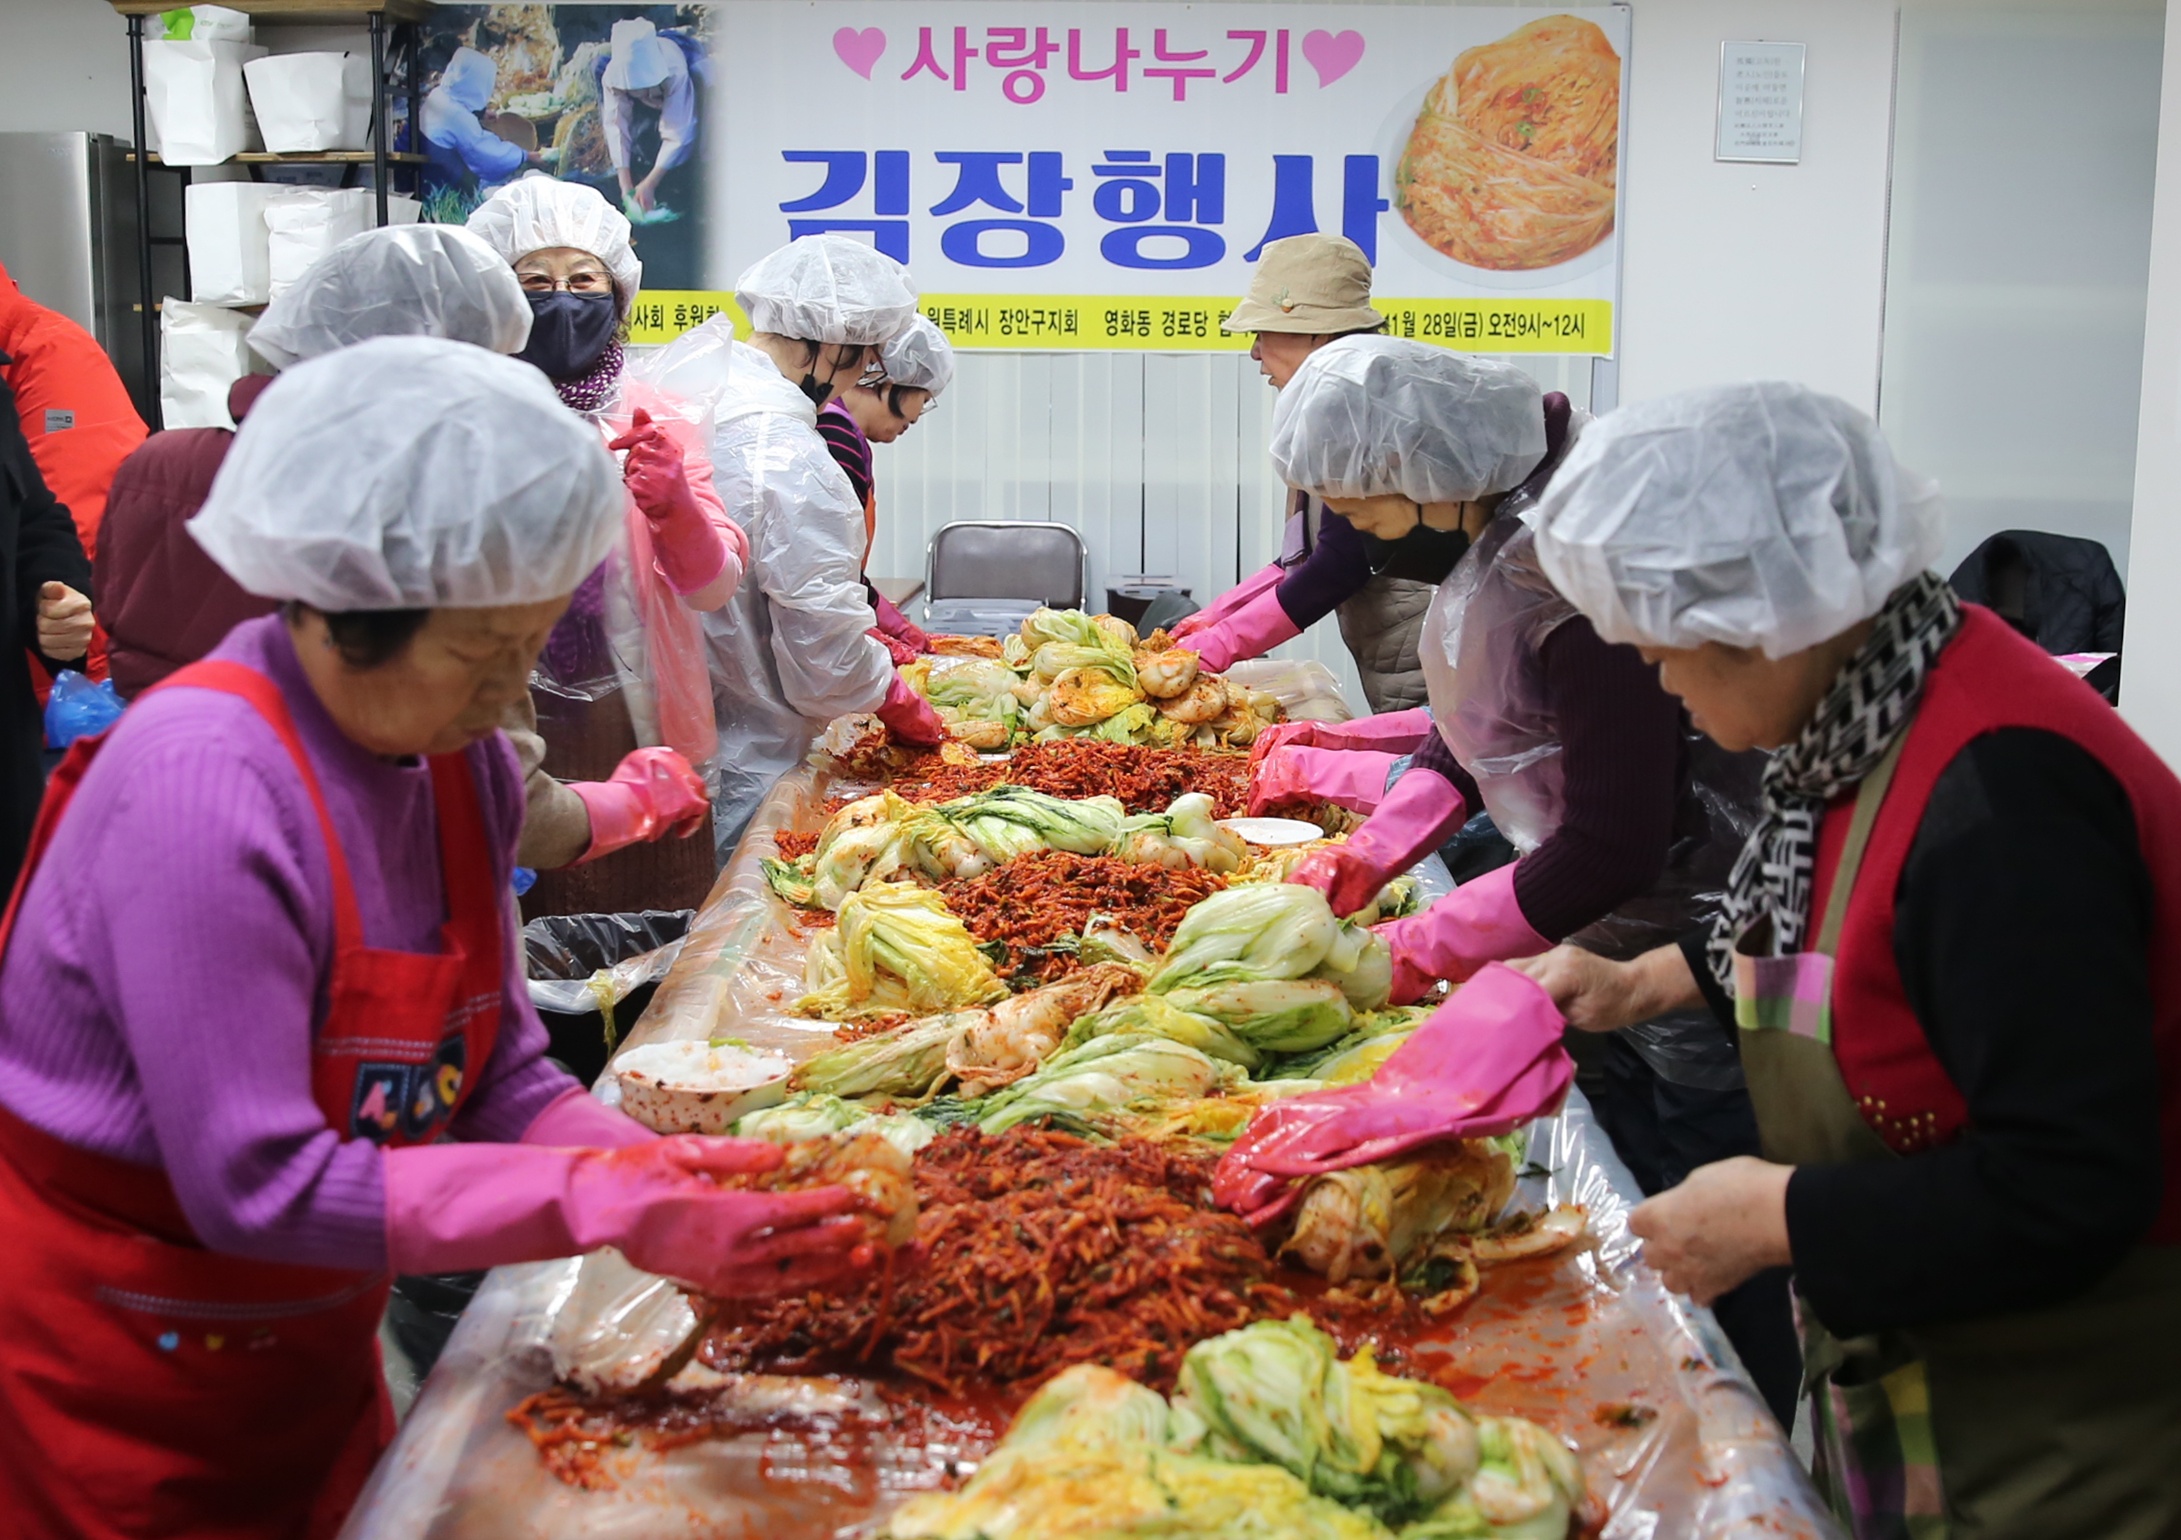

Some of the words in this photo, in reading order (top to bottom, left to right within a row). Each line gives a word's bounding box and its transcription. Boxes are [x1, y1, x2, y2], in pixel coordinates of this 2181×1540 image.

[901, 26, 1289, 105] 사랑나누기
[778, 149, 1390, 270] 김장행사
[629, 304, 664, 331] 사회
[916, 307, 989, 335] 원특례시
[999, 308, 1079, 336] 장안구지회
[1104, 310, 1152, 337] 영화동
[1161, 310, 1209, 337] 경로당
[1423, 311, 1483, 338] 28일(금)
[1488, 311, 1585, 338] 오전9시~12시
